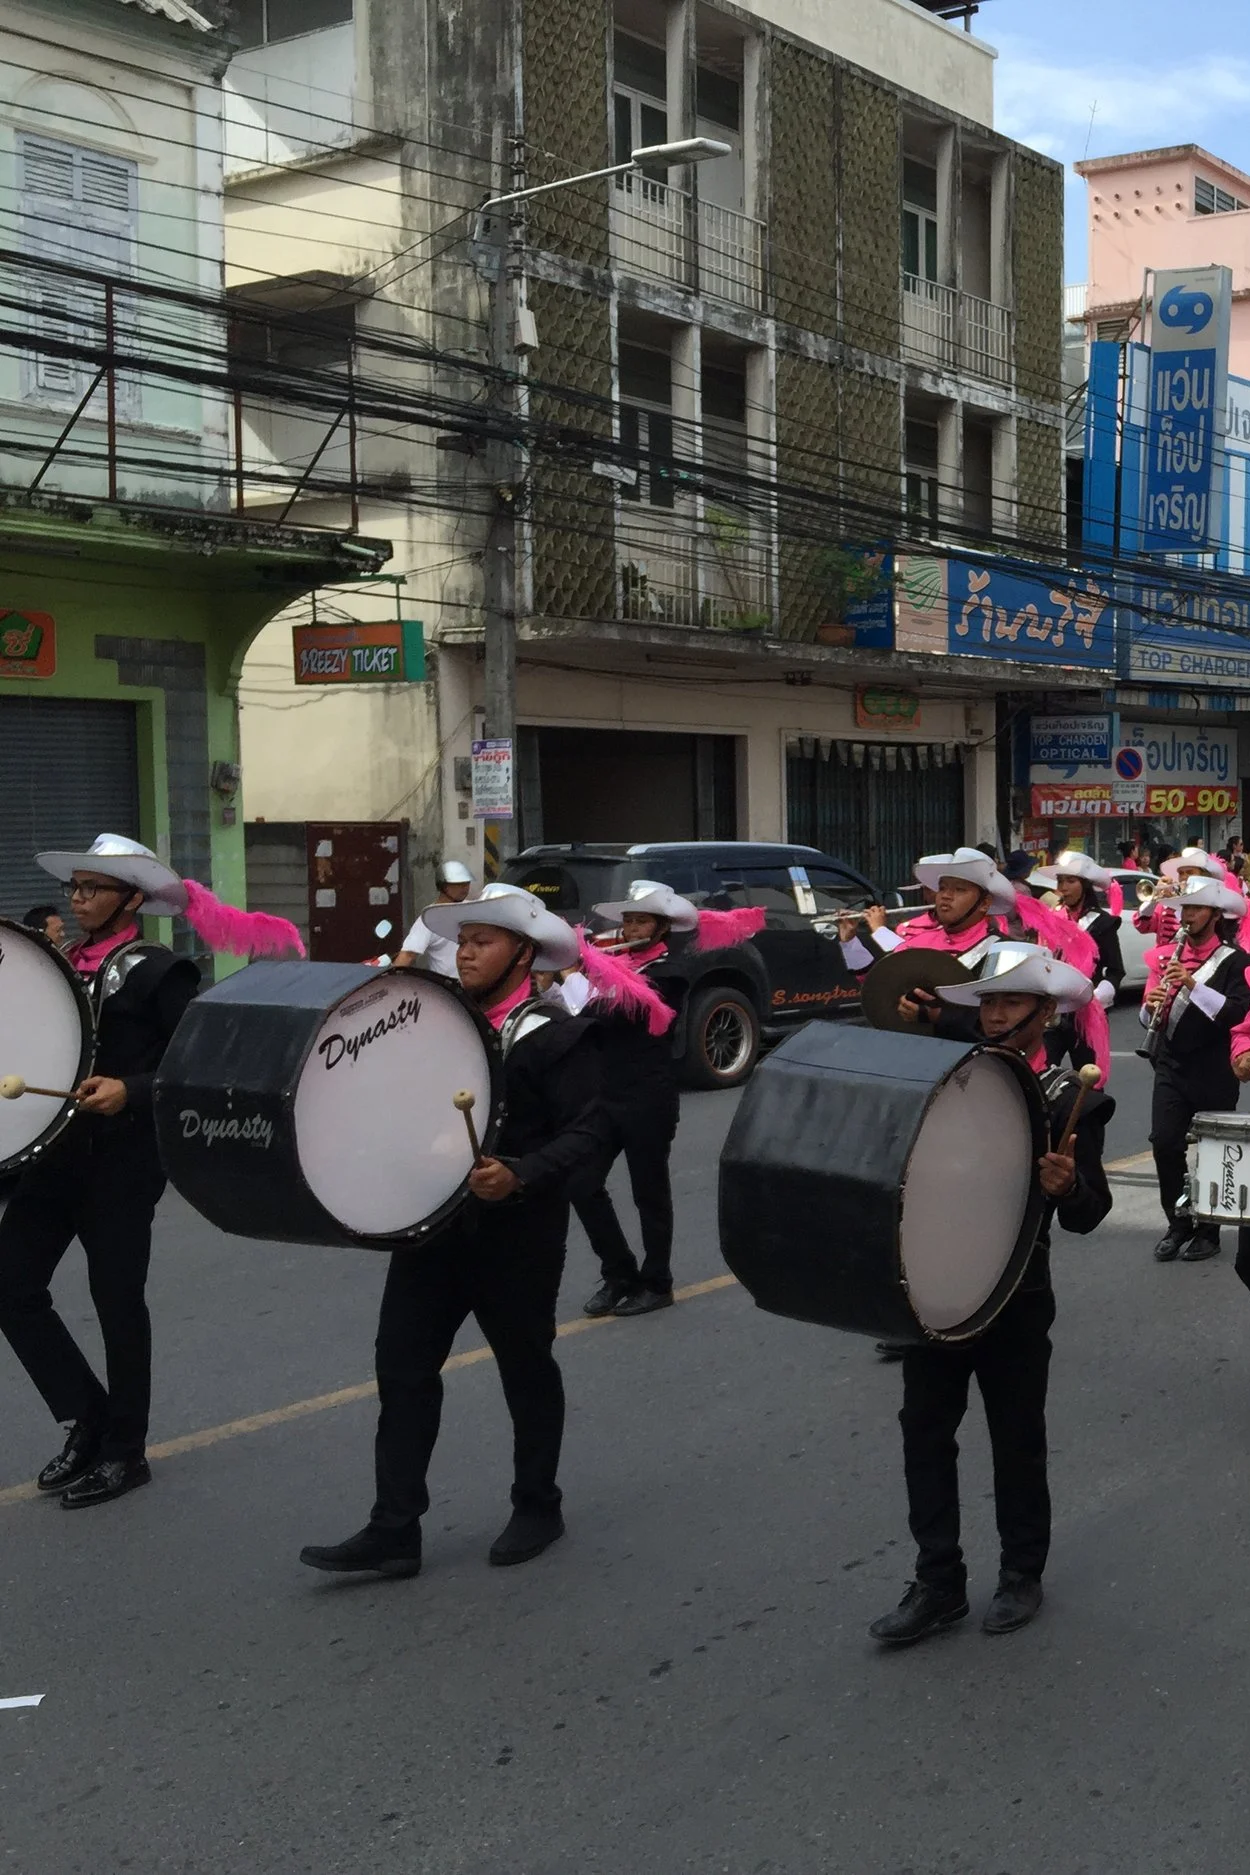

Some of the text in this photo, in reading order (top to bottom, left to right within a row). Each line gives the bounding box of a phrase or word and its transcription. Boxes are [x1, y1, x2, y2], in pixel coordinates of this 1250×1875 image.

[1156, 357, 1210, 411] แว่น
[1157, 415, 1205, 473] ท็อป
[1149, 485, 1207, 542] เจริญ
[301, 647, 398, 677] BREEZY TICKET
[1138, 650, 1173, 671] TOP
[1033, 734, 1107, 746] TOP CHAROEN
[1039, 748, 1100, 759] OPTICAL
[319, 994, 422, 1070] Dynasty
[179, 1109, 274, 1149] Dynasty
[1221, 1144, 1244, 1211] Dynasty
